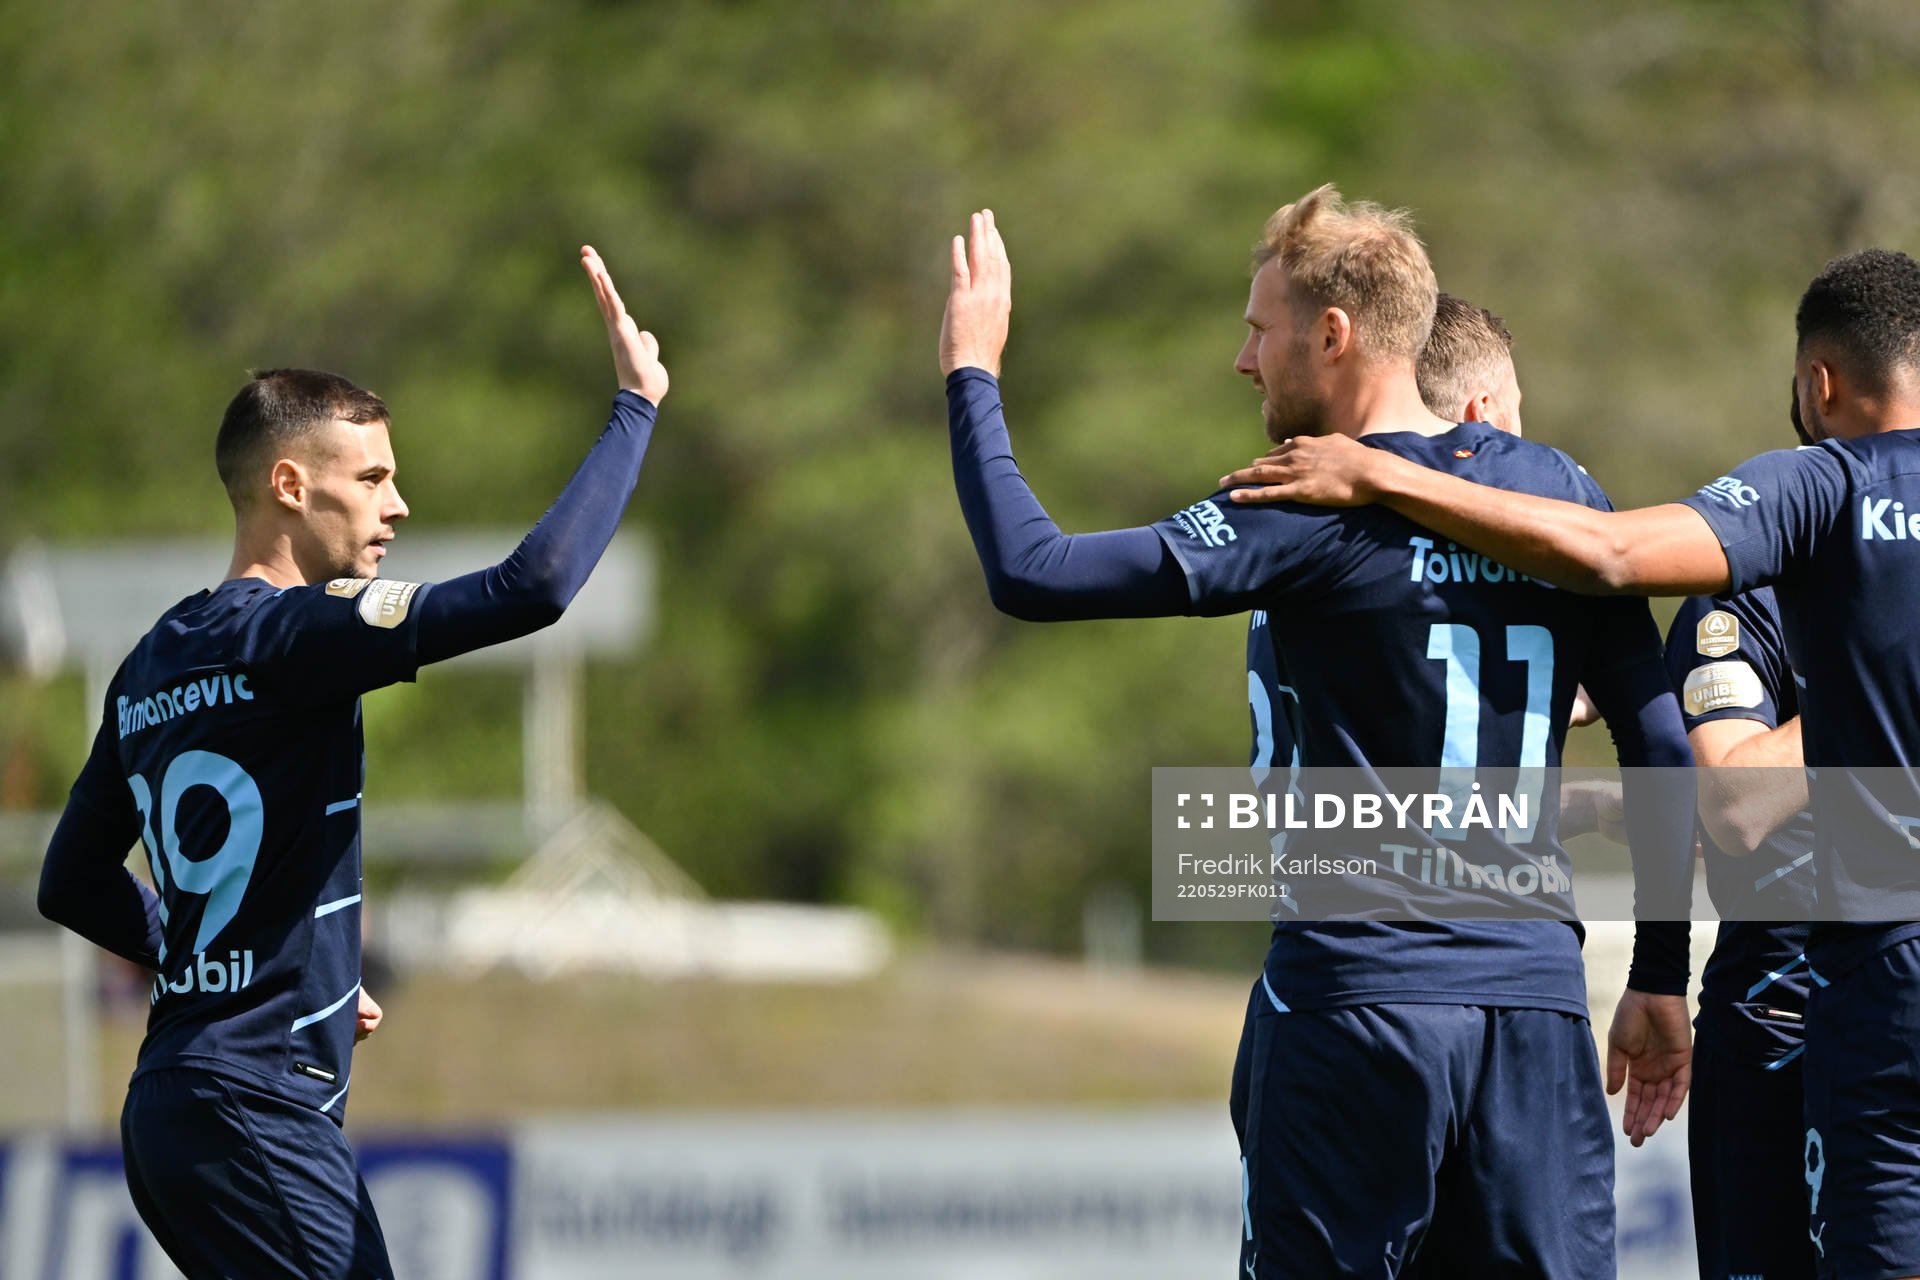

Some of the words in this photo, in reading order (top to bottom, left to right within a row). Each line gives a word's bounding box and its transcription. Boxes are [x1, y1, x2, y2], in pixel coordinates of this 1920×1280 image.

[117, 671, 254, 740] Birmancevic
[1426, 623, 1555, 844] 11
[127, 750, 264, 966] 19
[1805, 1128, 1825, 1215] 9
